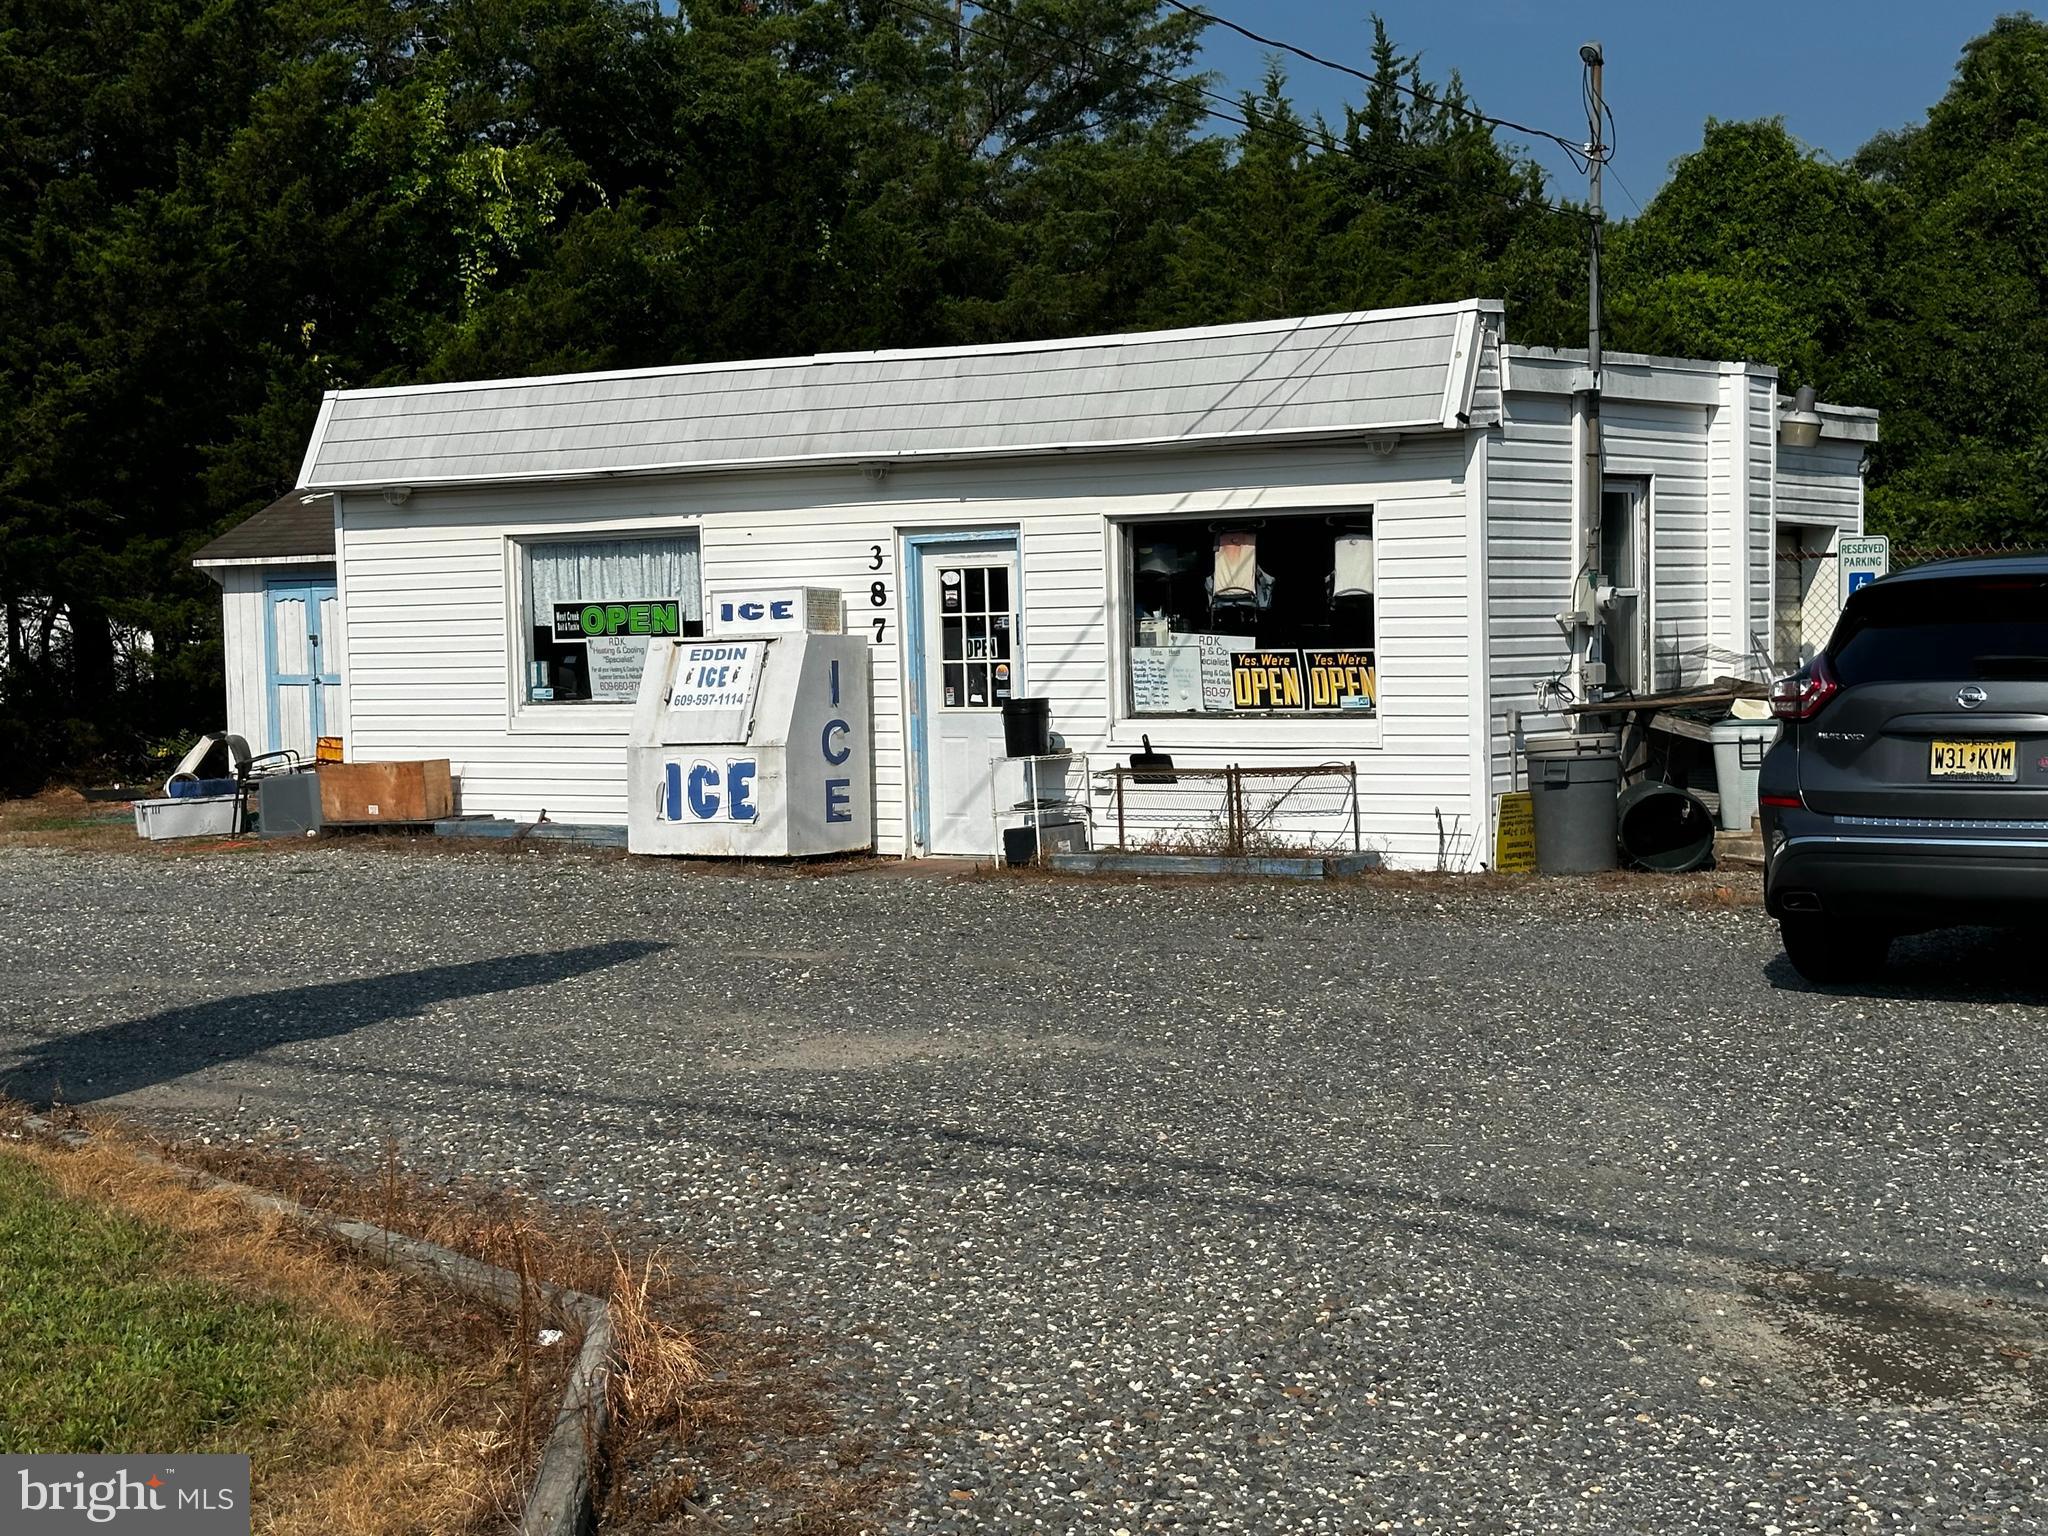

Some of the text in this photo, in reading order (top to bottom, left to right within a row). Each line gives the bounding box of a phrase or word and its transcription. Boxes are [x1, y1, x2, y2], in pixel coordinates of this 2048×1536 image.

[1841, 543, 1884, 554] RESERVED
[1843, 556, 1882, 567] PARKING
[580, 603, 678, 635] OPEN
[720, 600, 794, 622] ICE
[622, 646, 645, 655] Cooling
[690, 647, 747, 661] EDDIN
[1238, 653, 1290, 666] Yes, We're
[1338, 653, 1367, 665] We're
[697, 665, 730, 688] ICE
[1234, 667, 1301, 706] OPEN
[1311, 666, 1376, 706] OPEN
[674, 692, 744, 706] 609-597-1114
[821, 659, 852, 823] ICE
[1935, 747, 1966, 769] W31
[1978, 747, 2012, 769] KVM
[665, 757, 758, 821] ICE
